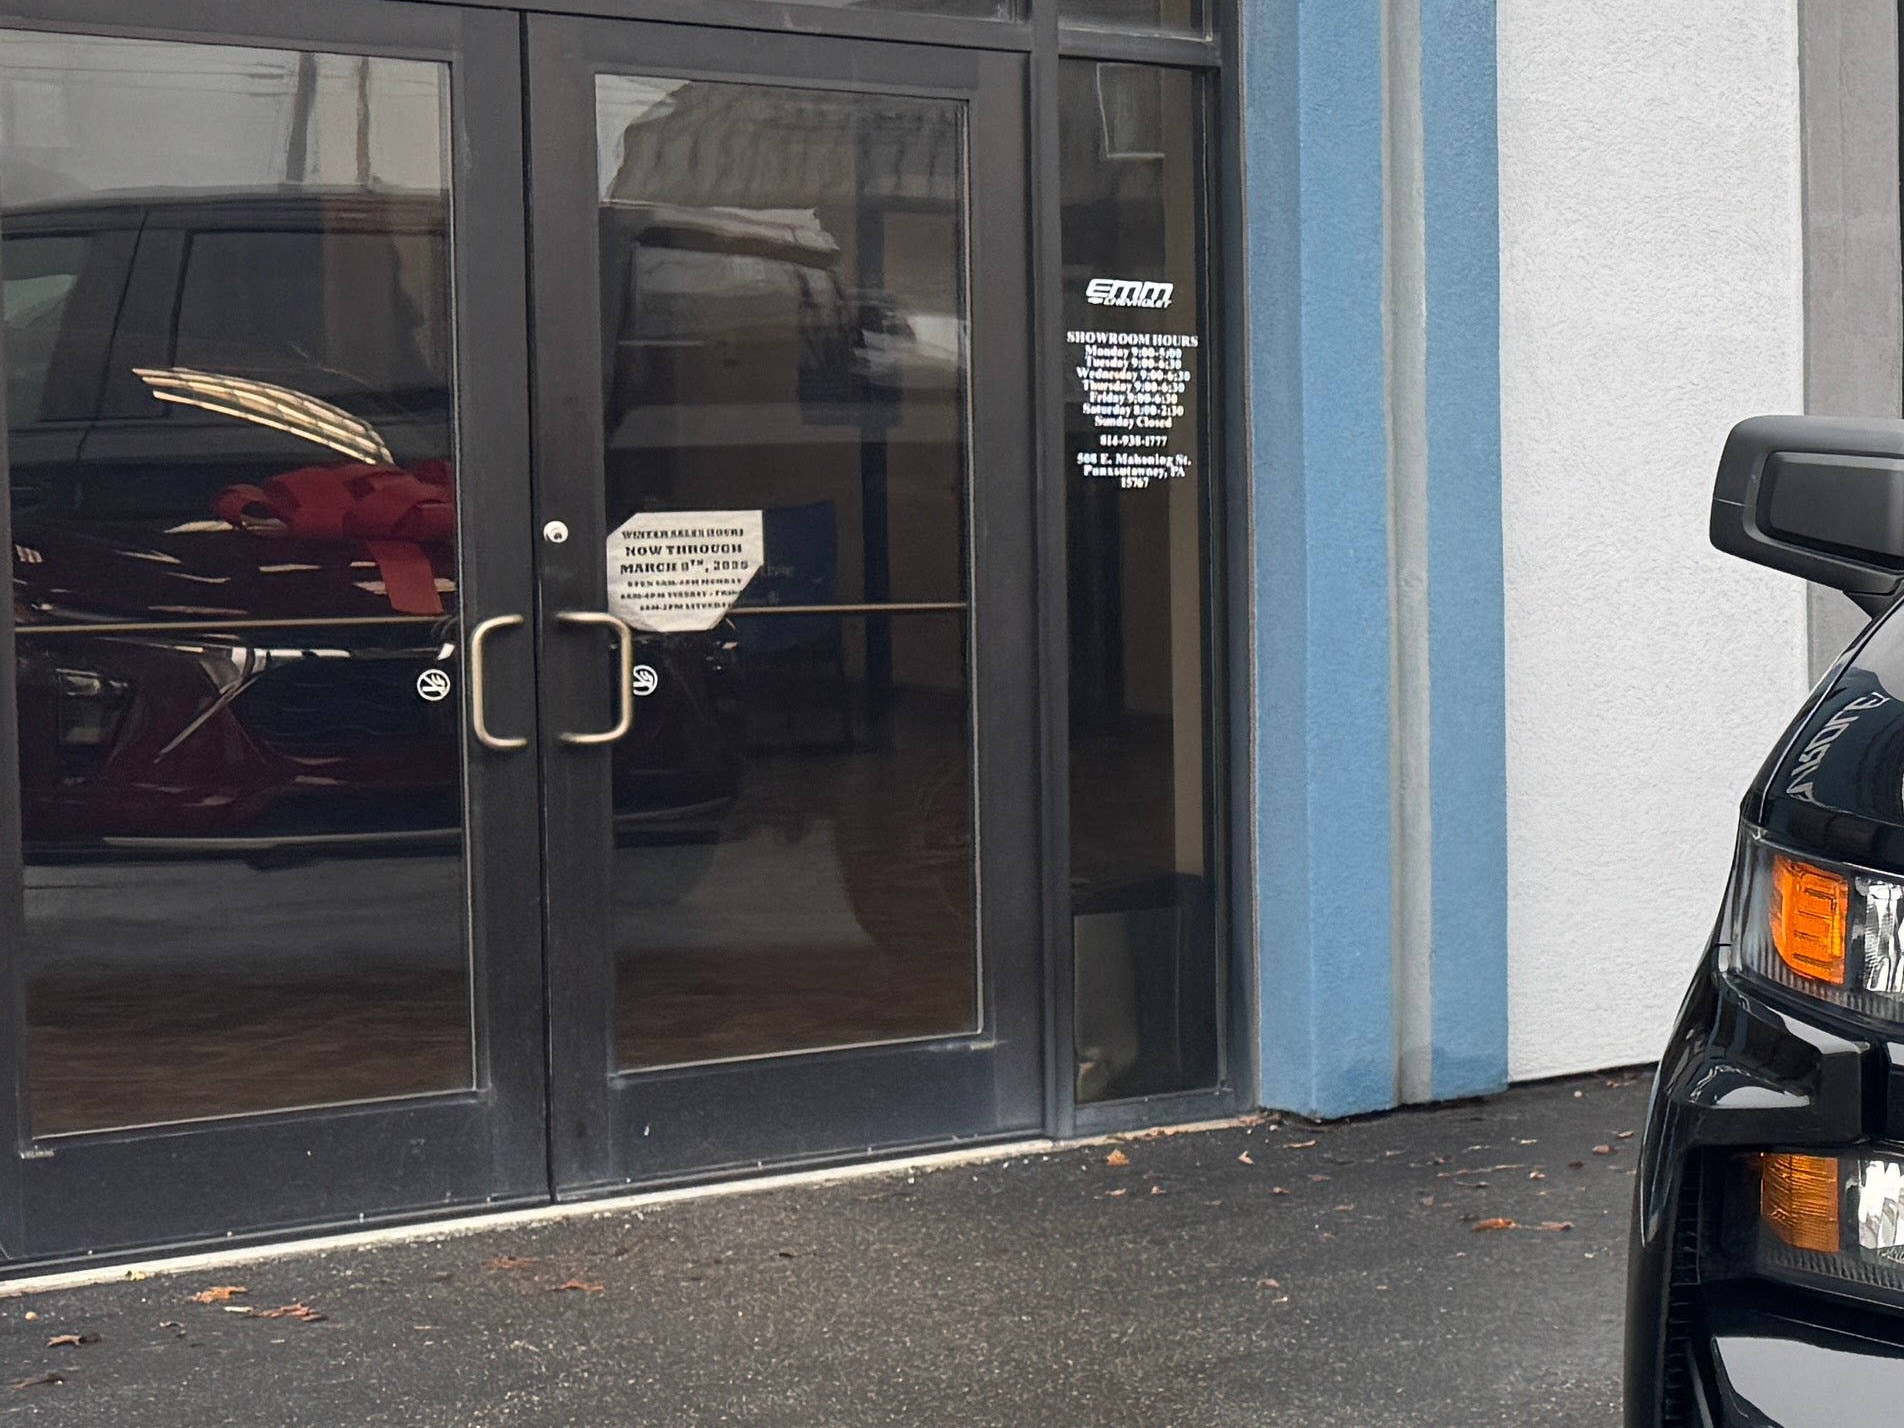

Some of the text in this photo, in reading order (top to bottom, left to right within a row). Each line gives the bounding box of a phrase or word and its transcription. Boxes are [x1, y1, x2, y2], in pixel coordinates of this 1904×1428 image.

[1067, 330, 1199, 348] SHOWROOM HOURS
[1085, 345, 1130, 360] Monday
[1085, 356, 1130, 371] Tuesday
[1076, 367, 1139, 382] Wednesday
[1082, 379, 1133, 395] Thursday
[1089, 391, 1126, 405] Friday
[1082, 403, 1132, 417] Saturday
[1094, 415, 1173, 430] Sunday Closed
[622, 529, 668, 541] WINTER
[706, 527, 745, 538] HOURS
[625, 543, 743, 557] NOW THROUGH
[620, 562, 677, 575] MARCH
